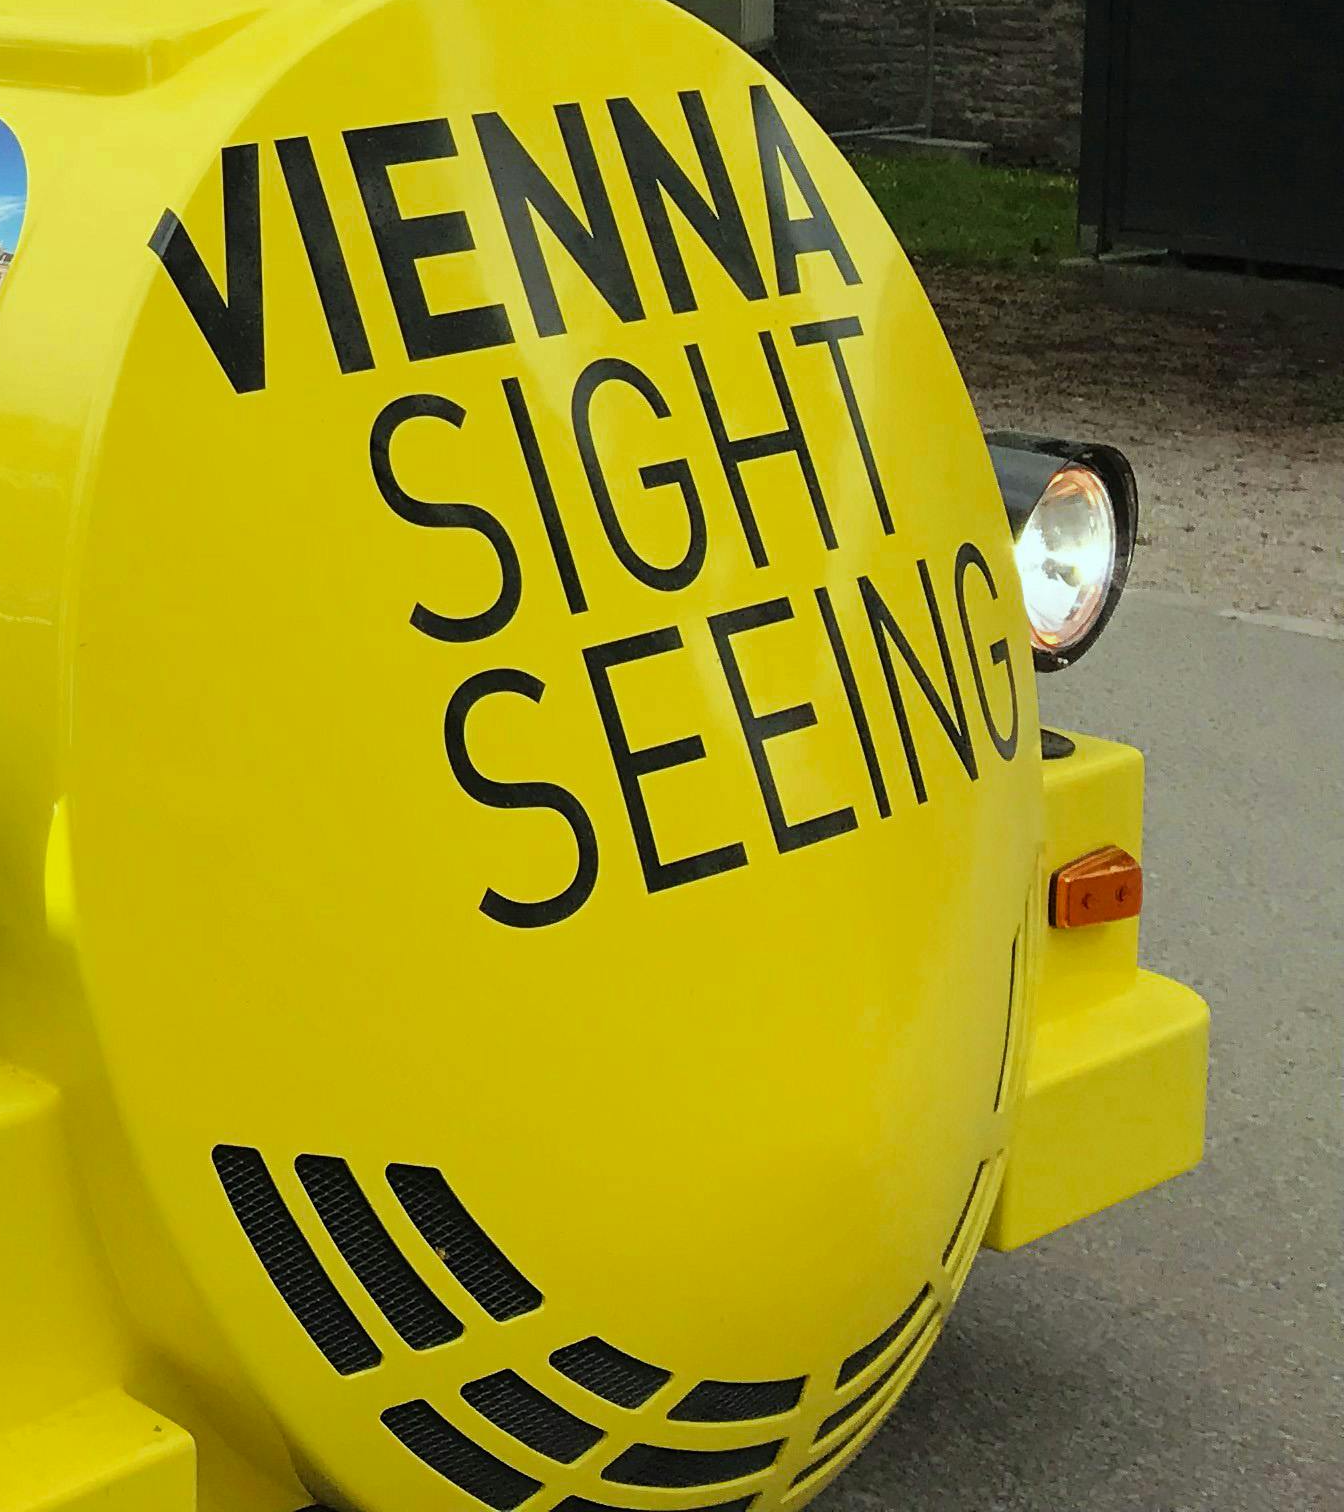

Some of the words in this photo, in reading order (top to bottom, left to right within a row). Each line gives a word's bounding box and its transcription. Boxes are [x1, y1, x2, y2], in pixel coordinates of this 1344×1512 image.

[148, 84, 863, 394] VIENNA
[369, 316, 895, 644] SIGHT
[443, 541, 1019, 929] SEEING
